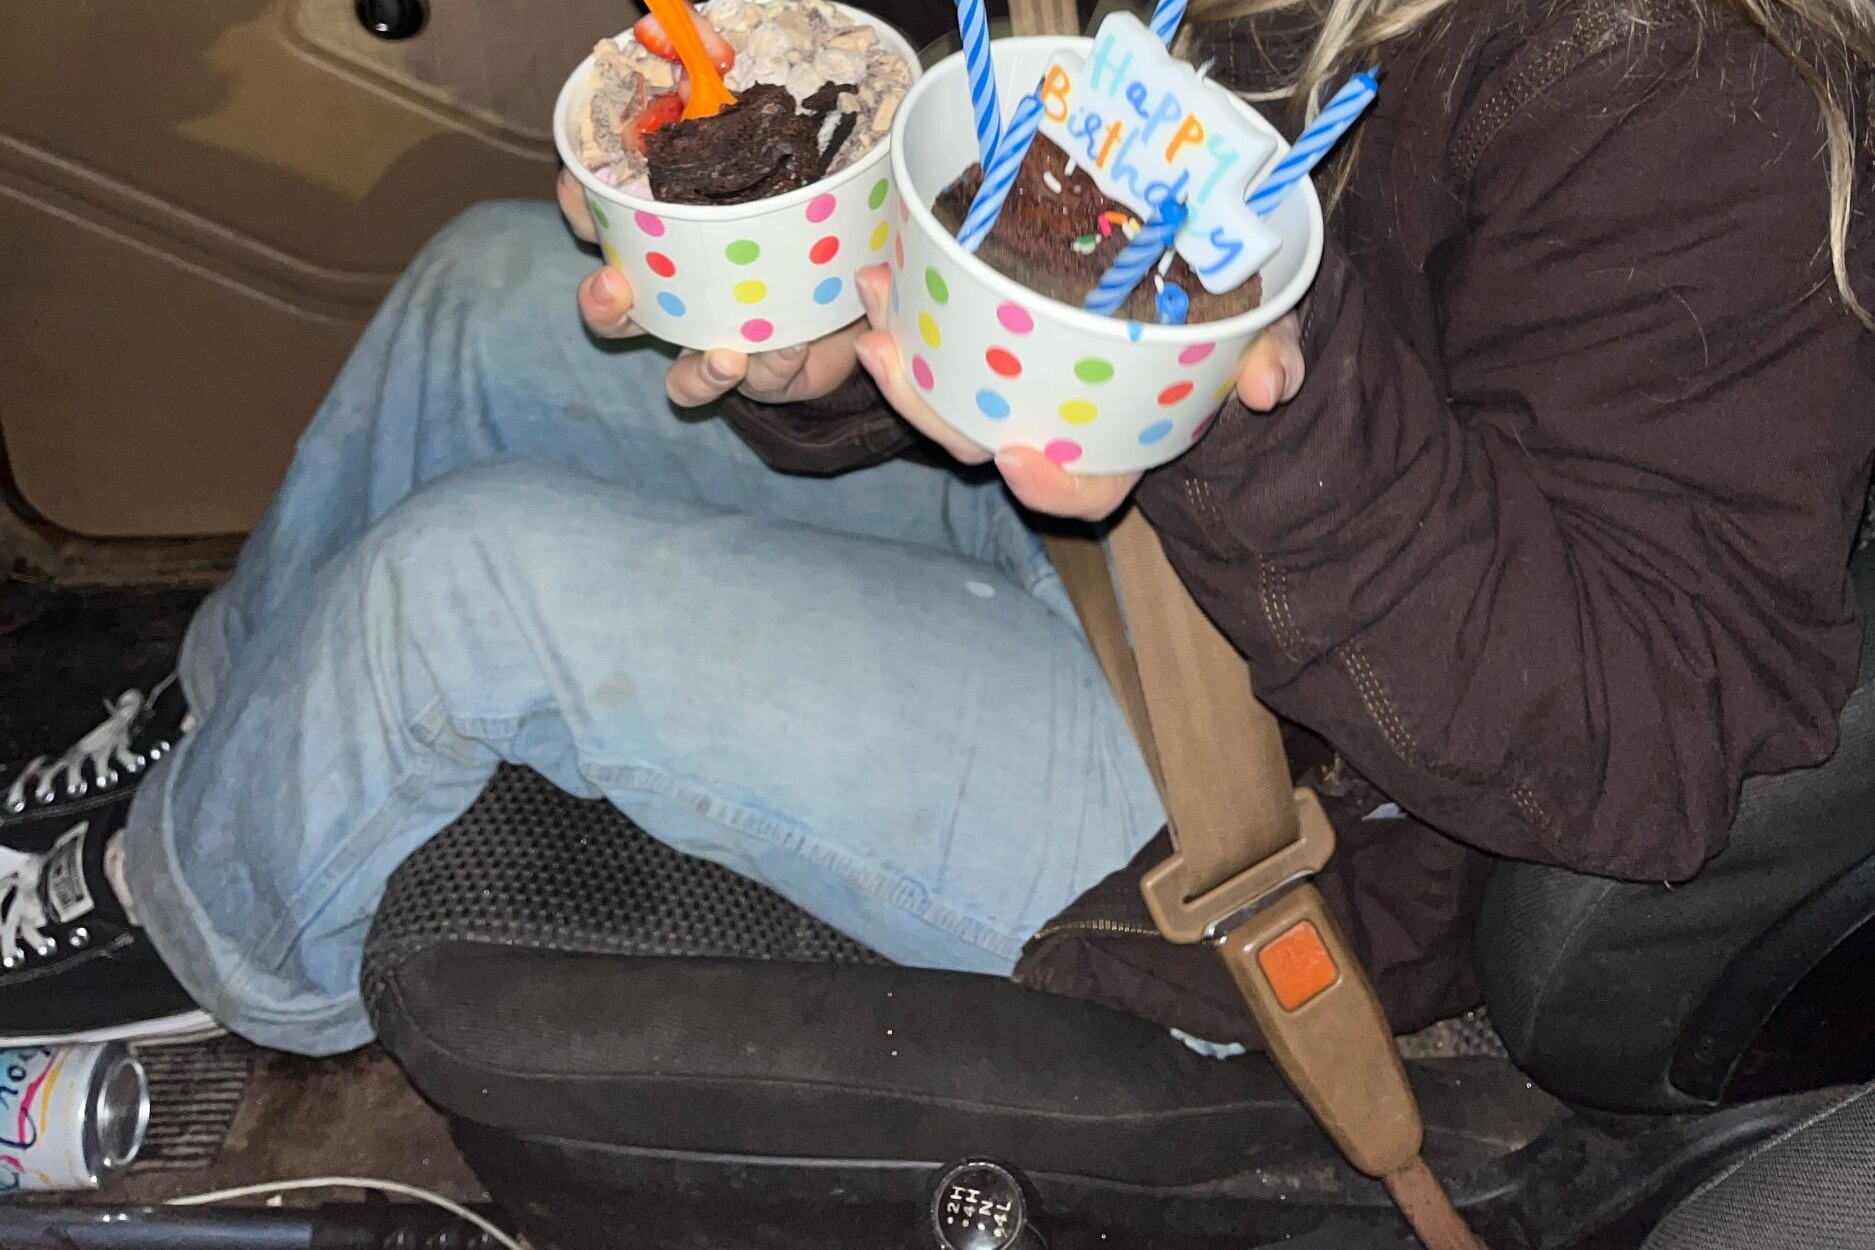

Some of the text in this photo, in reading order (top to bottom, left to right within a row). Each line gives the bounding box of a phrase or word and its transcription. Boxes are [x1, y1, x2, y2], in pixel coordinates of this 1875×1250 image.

[1089, 33, 1240, 204] Happy
[947, 1185, 965, 1214] 2H
[963, 1188, 981, 1218] 4H
[978, 1199, 994, 1216] N
[993, 1200, 1012, 1227] 4L
